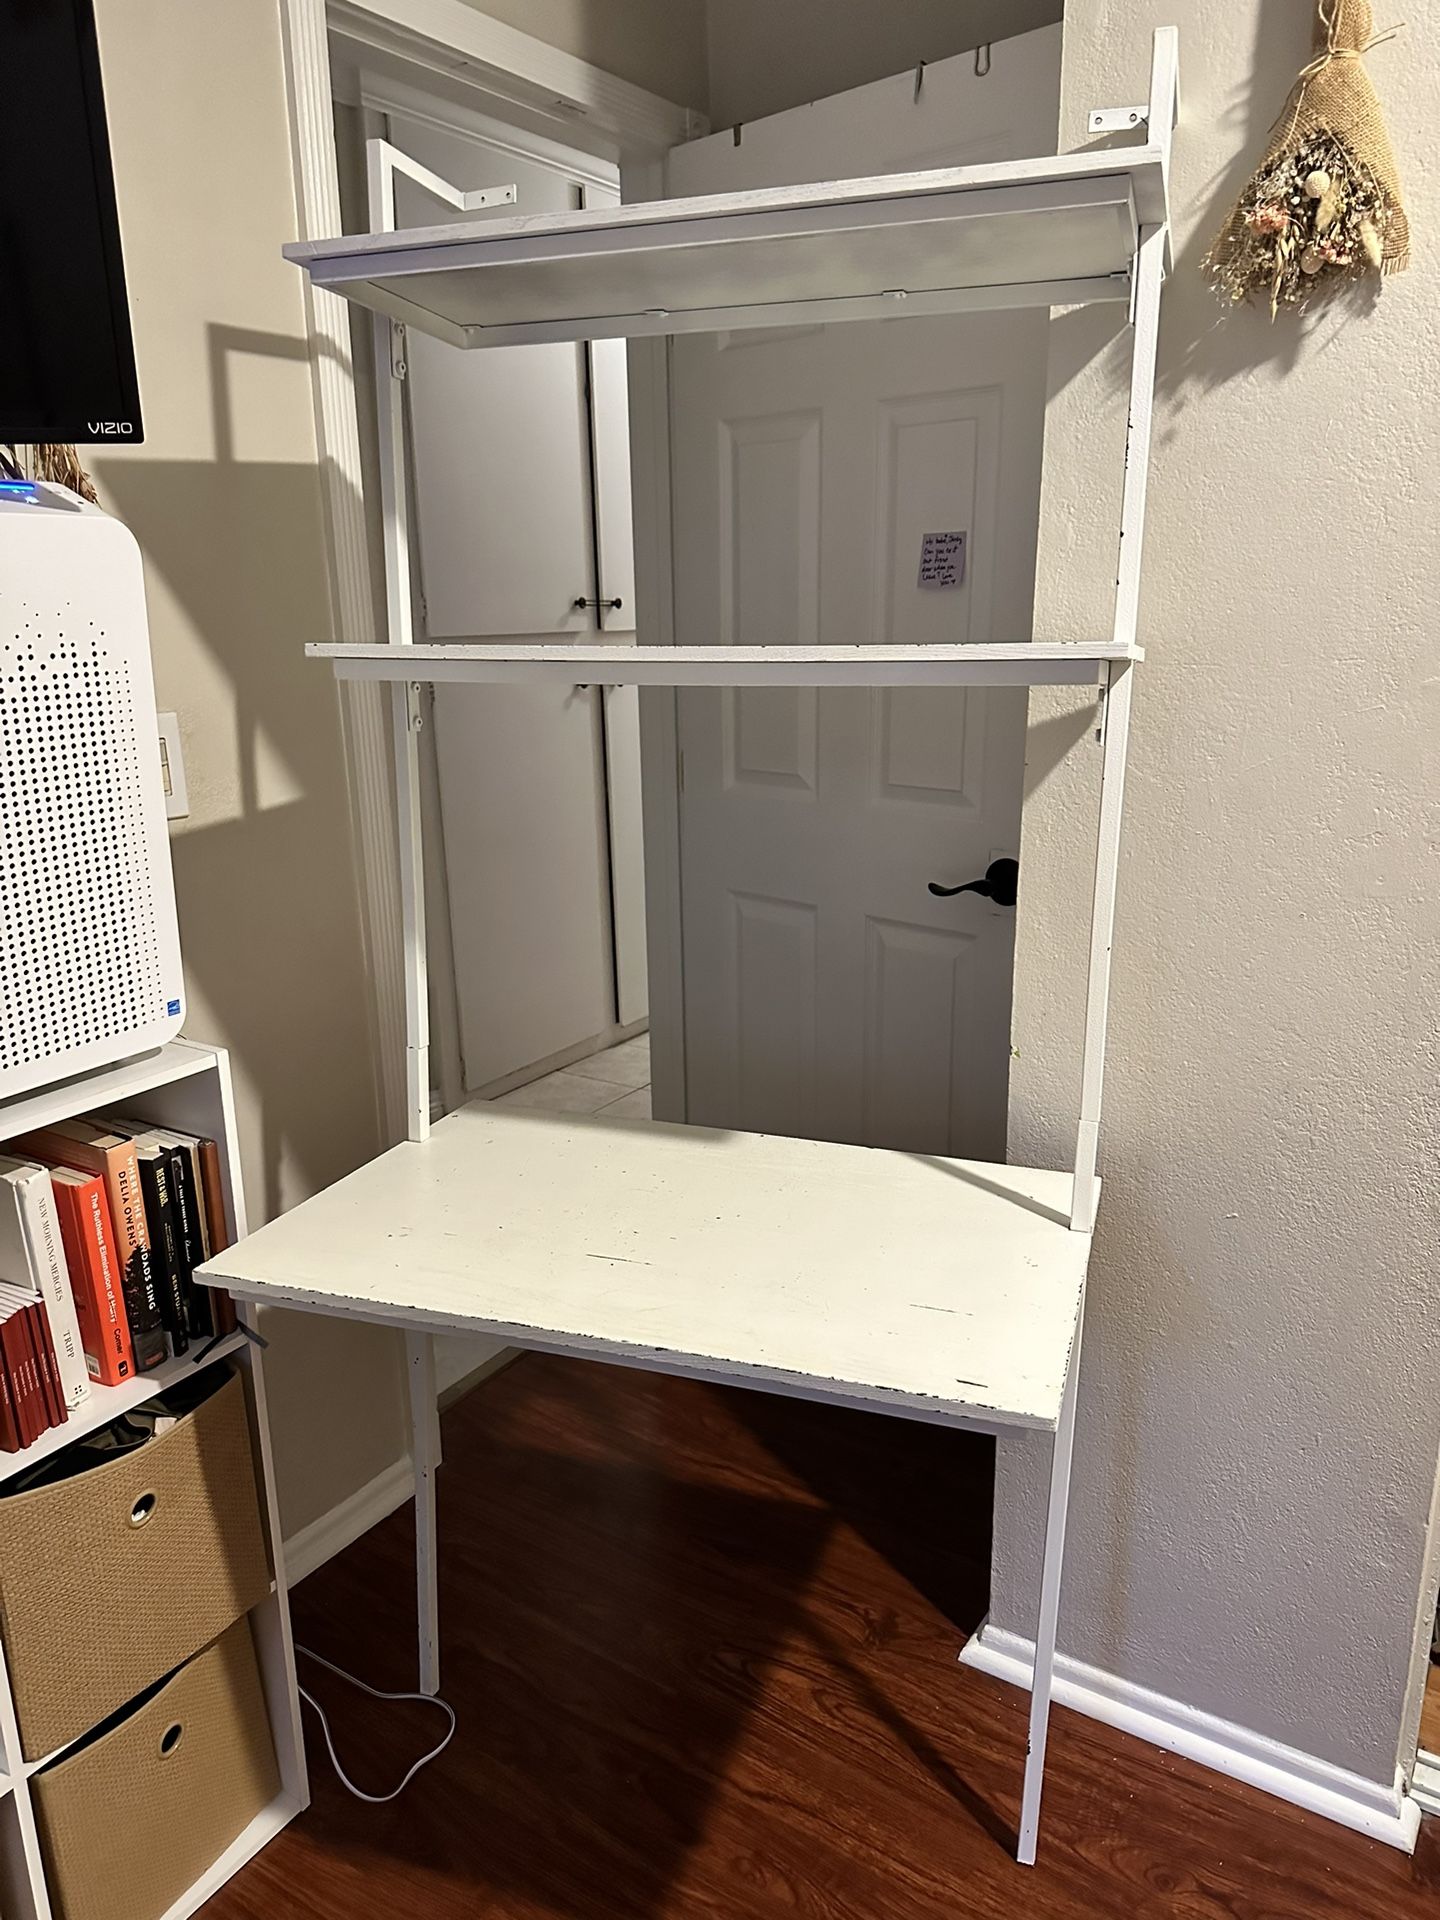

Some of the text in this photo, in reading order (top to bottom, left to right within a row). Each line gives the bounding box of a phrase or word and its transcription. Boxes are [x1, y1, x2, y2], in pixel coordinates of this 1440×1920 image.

[87, 421, 133, 434] VIZIO
[127, 1155, 139, 1196] WHERE
[155, 1167, 166, 1187] REST
[91, 1191, 99, 1210] The
[118, 1170, 138, 1247] DELIA OWENS
[132, 1196, 143, 1219] THE
[93, 1208, 105, 1246] Ruthless
[38, 1197, 63, 1302] NEW MORNING MERCIES
[136, 1221, 152, 1282] CRAWDADS
[99, 1244, 113, 1291] Elimination
[106, 1289, 115, 1301] of
[171, 1273, 179, 1291] BEN
[145, 1283, 156, 1311] SING
[63, 1329, 75, 1358] TRIPP
[113, 1327, 123, 1355] Comer
